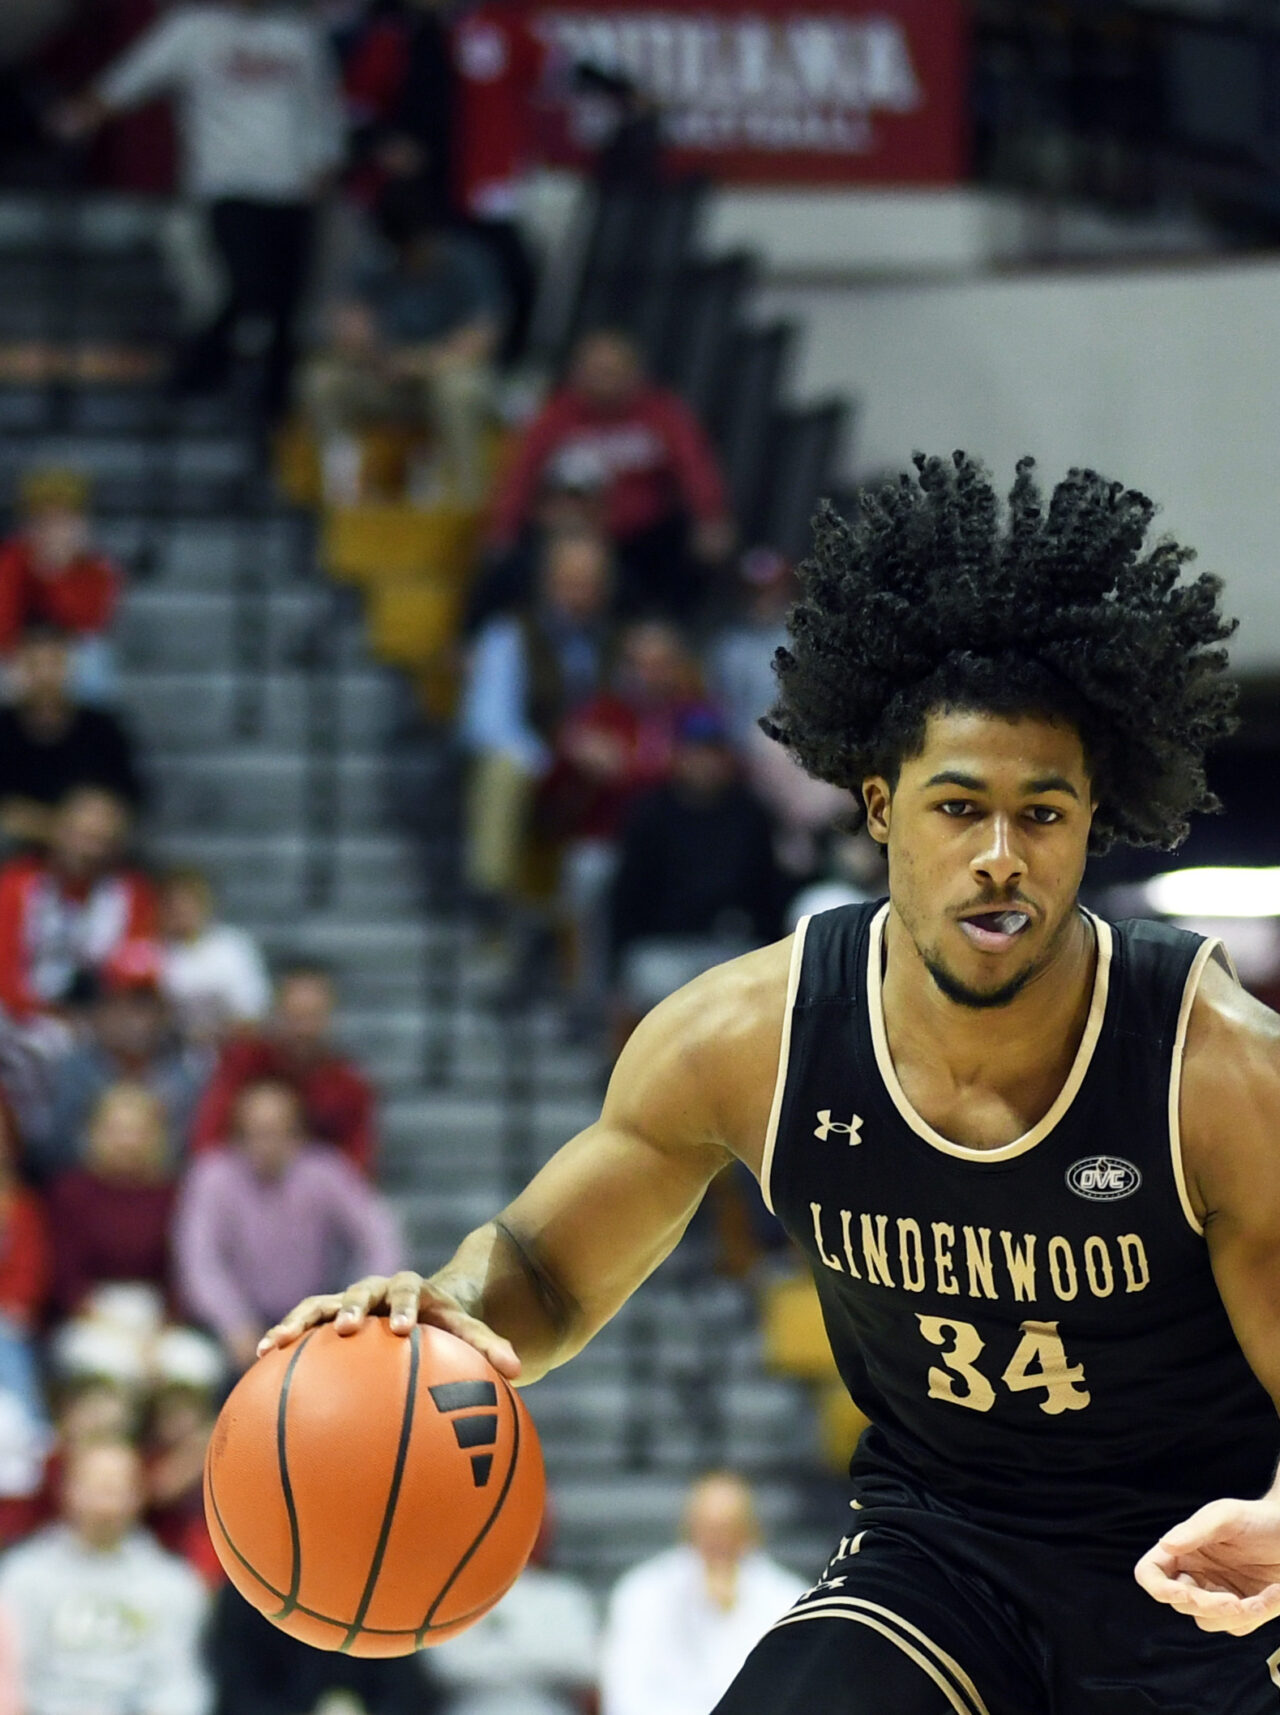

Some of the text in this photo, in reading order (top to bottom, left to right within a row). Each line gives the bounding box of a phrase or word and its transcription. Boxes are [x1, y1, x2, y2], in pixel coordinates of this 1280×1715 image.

[1080, 1168, 1126, 1190] OVC
[810, 1202, 1151, 1302] LINDENWOOD
[914, 1312, 1091, 1415] 34
